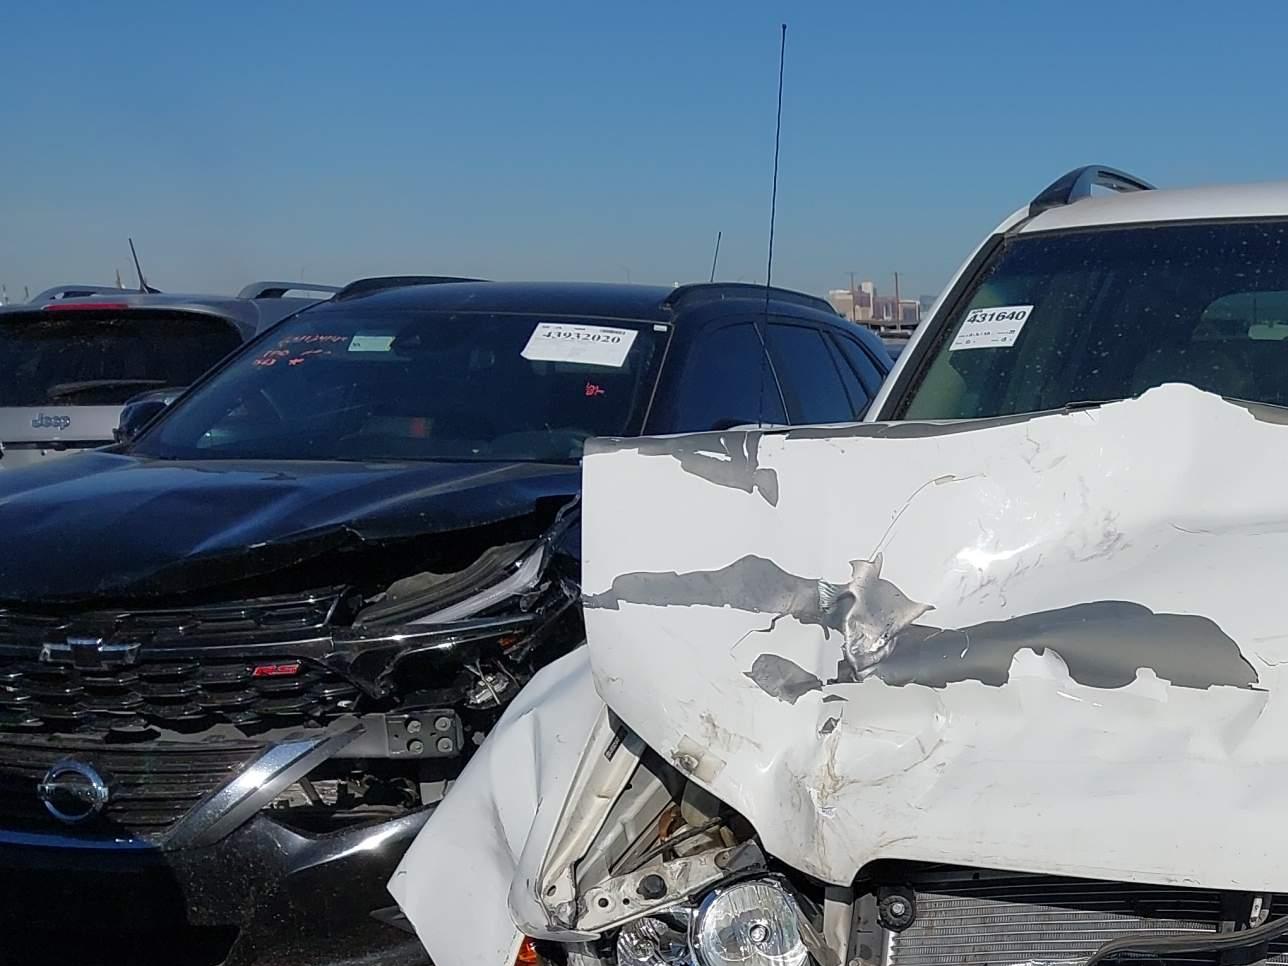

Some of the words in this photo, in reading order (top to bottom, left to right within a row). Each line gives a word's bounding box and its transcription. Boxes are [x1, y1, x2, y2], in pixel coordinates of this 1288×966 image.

[967, 311, 1027, 323] 431640
[31, 412, 71, 431] Jeep
[252, 663, 299, 676] RS
